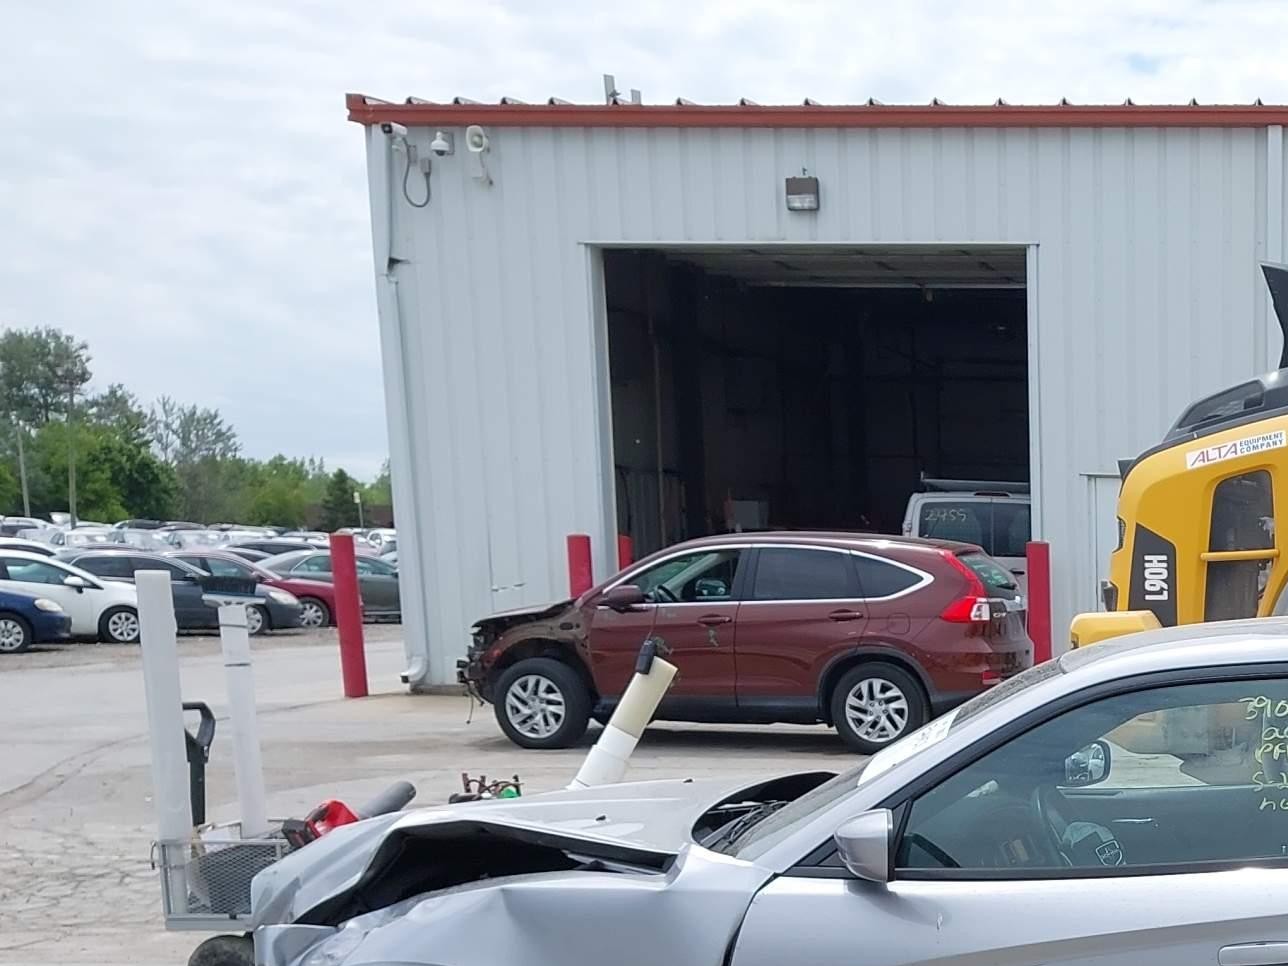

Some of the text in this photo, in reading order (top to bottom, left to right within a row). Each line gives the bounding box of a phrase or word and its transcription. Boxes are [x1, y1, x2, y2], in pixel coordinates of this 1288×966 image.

[1239, 432, 1283, 447] EQUIPMENT
[1240, 440, 1283, 454] COMPANY
[1190, 443, 1238, 467] ALTA
[1144, 555, 1168, 600] L90H
